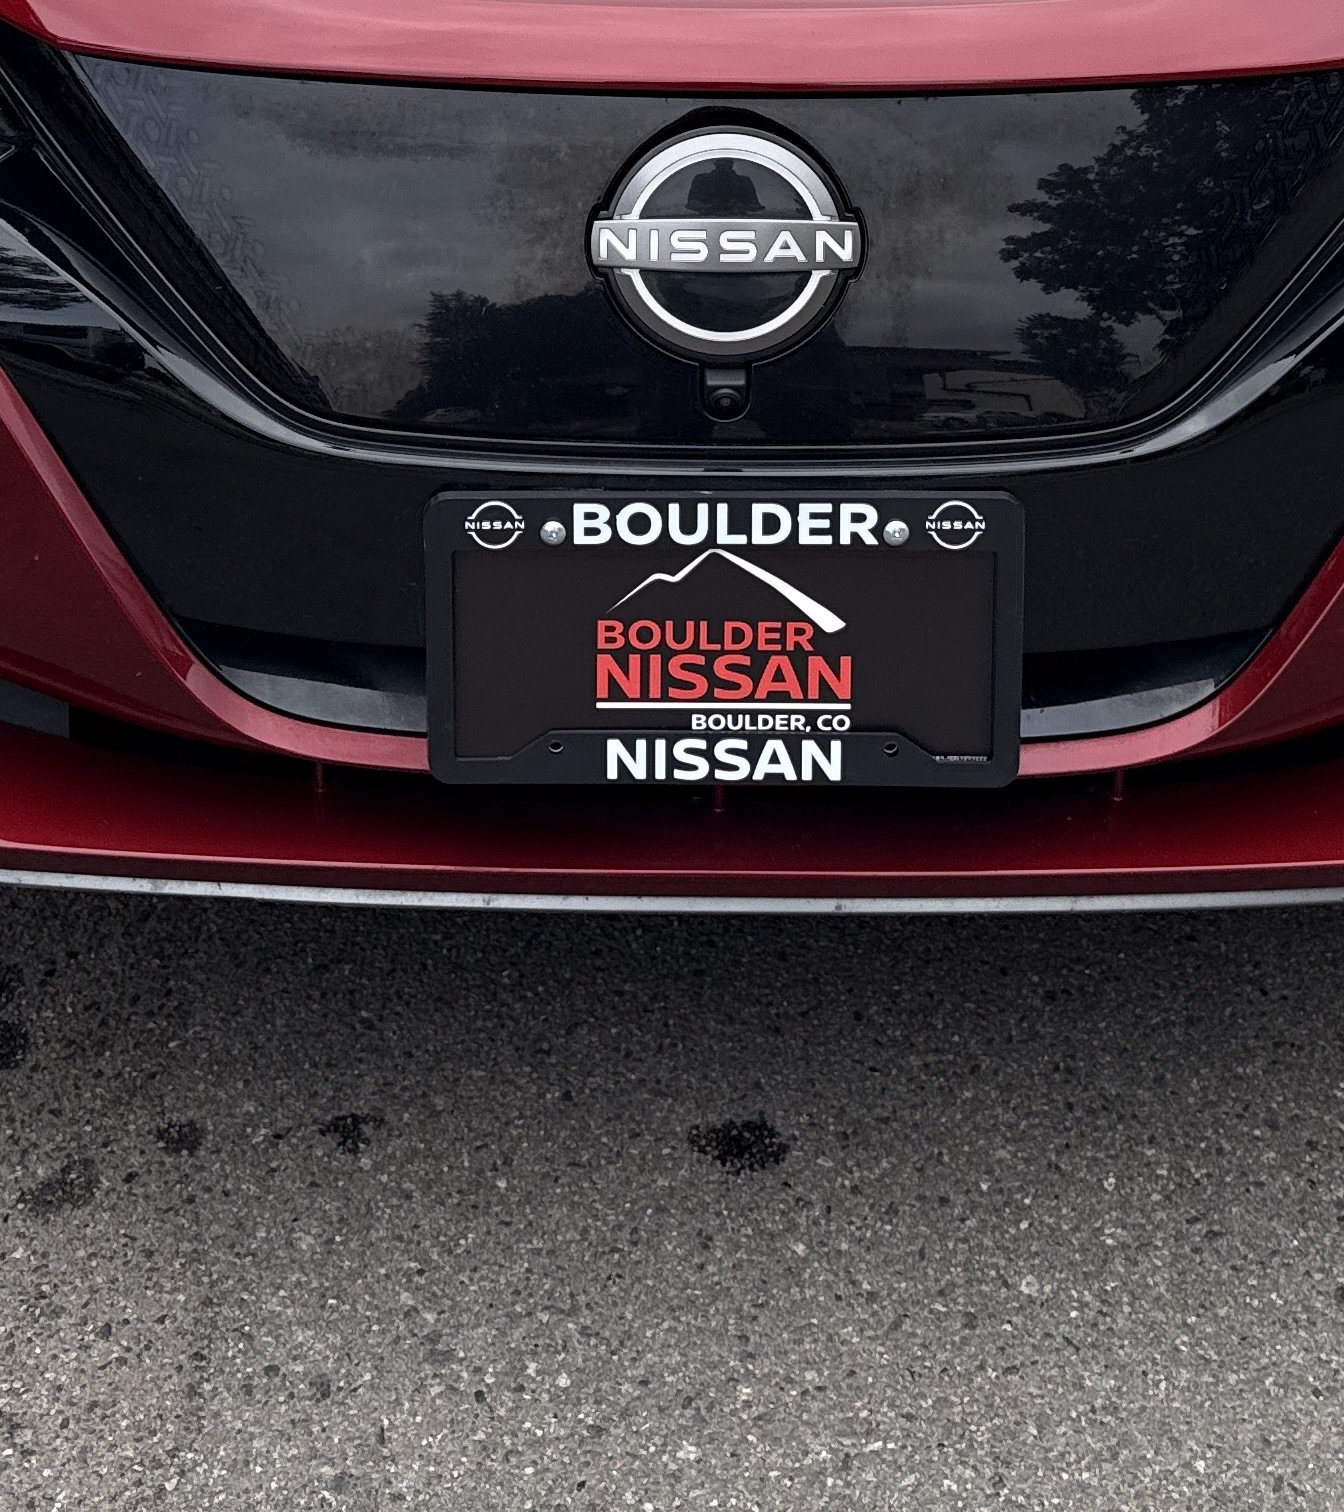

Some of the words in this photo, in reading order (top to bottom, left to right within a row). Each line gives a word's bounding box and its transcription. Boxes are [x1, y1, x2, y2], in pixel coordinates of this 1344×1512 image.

[598, 228, 854, 263] NISSAN
[464, 520, 525, 530] NISSAN
[572, 501, 880, 546] BOULDER
[925, 520, 986, 530] NISSAN
[596, 620, 814, 651] BOULDER
[596, 654, 852, 700] NISSAN
[691, 713, 811, 734] BOULDER,
[817, 713, 851, 732] CO
[605, 738, 842, 782] NISSAN
